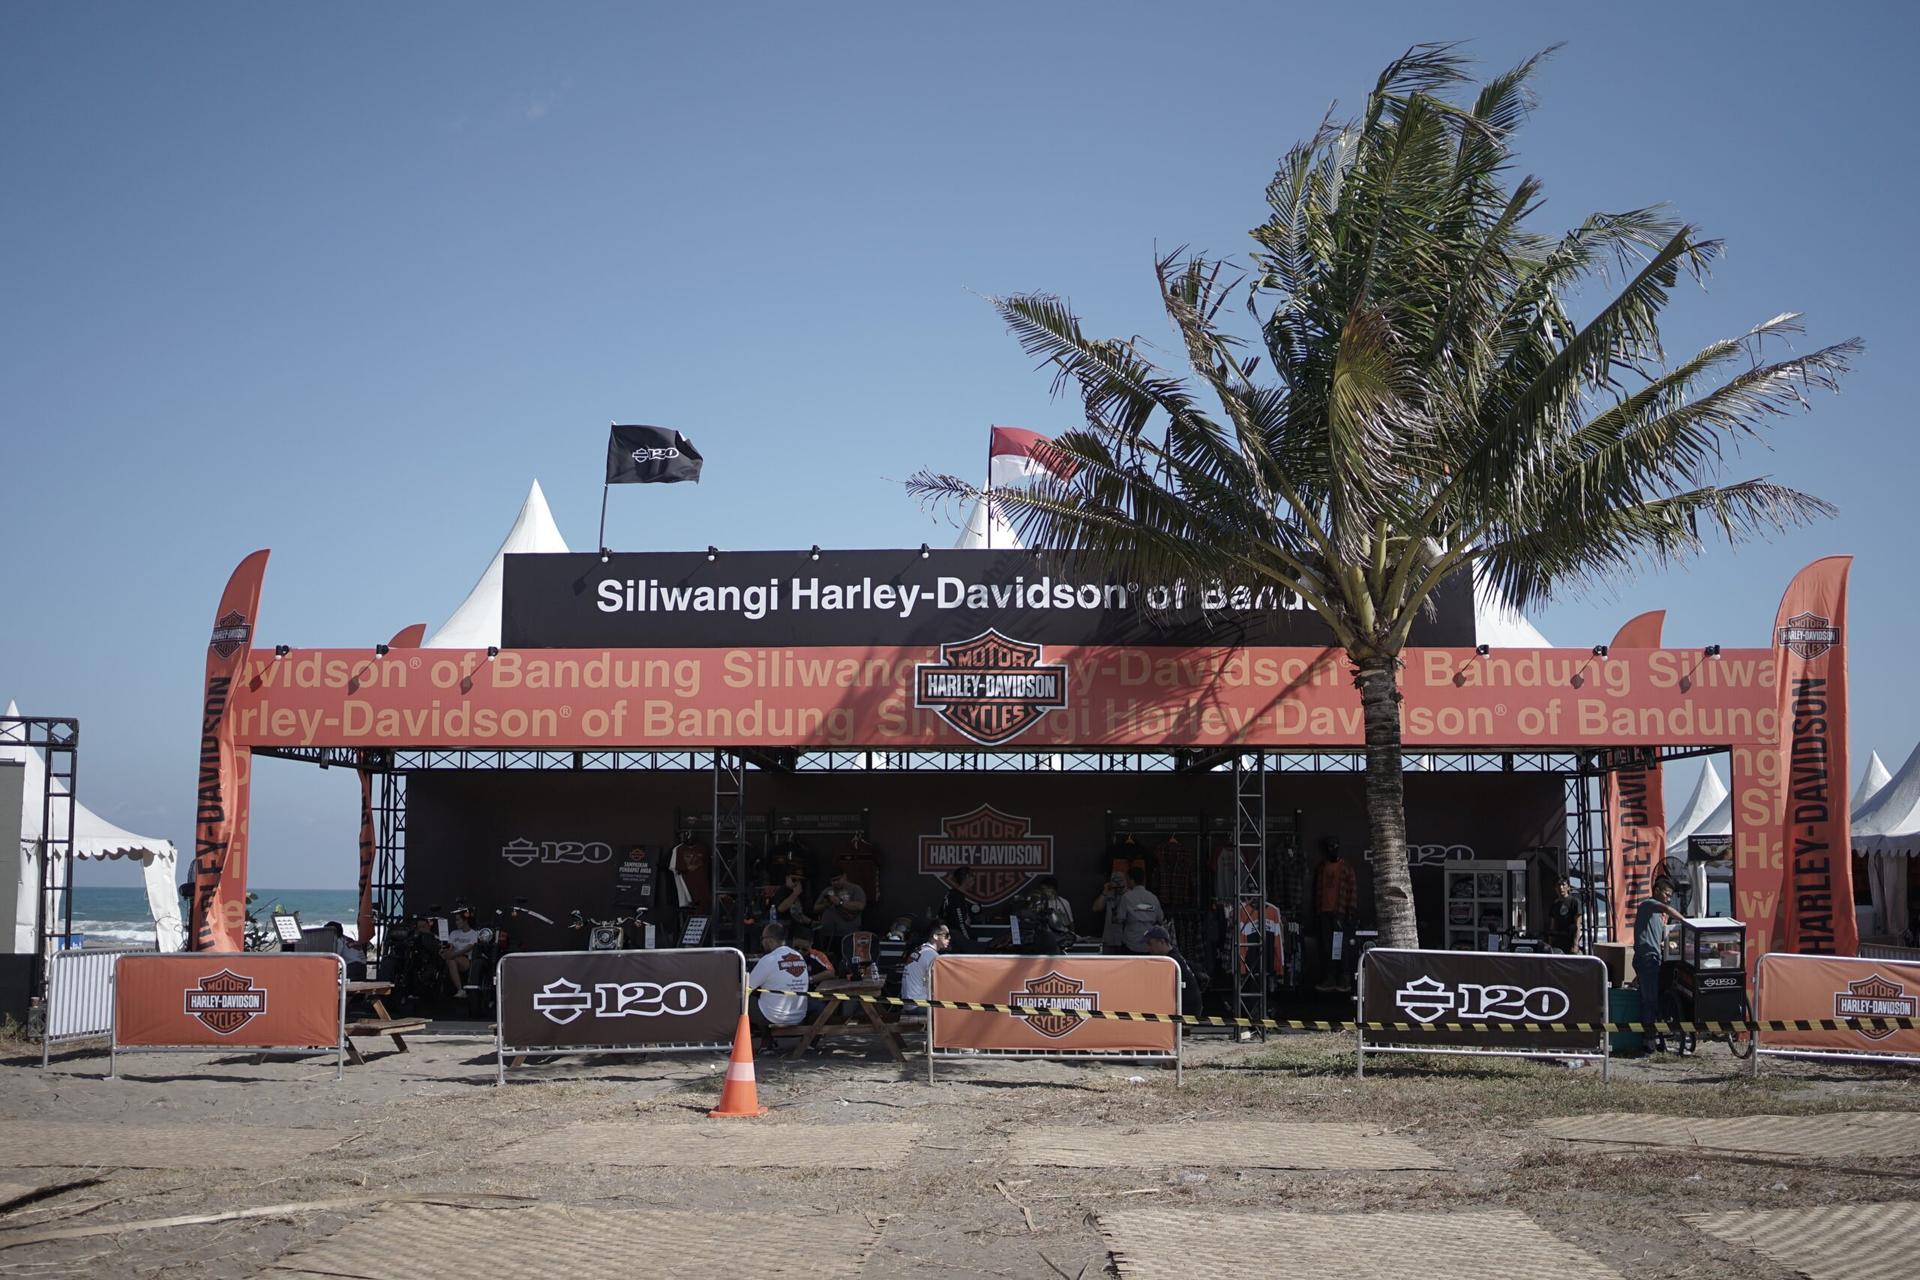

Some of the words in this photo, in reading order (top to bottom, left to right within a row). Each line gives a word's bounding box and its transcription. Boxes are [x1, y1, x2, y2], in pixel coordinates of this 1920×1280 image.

[597, 578, 778, 619] Siliwangi
[1783, 630, 1835, 642] HARLEY-DAVIDSON
[958, 640, 1025, 667] MOTOR
[430, 651, 476, 689] of
[492, 651, 701, 697] Bandung
[1424, 650, 1630, 697] Bandung
[928, 674, 1057, 698] HARLEY-DAVIDSON
[581, 699, 627, 738] of
[643, 699, 854, 744] Bandung
[1517, 699, 1562, 737] of
[1578, 698, 1779, 744] Bandung
[957, 705, 1025, 735] CYCLES
[1791, 678, 1836, 954] HARLEY-DAVIDSON
[956, 816, 1017, 838] MOTOR
[541, 842, 613, 863] 120
[930, 844, 1042, 865] HARLEY-DAVIDSON
[207, 976, 245, 991] MOTOR
[1034, 979, 1074, 994] MOTOR
[1857, 982, 1895, 998] MOTOR
[191, 995, 260, 1008] HARLEY-DAVIDSON
[595, 981, 708, 1017] 120
[1017, 997, 1092, 1011] HARLEY-DAVIDSON
[1458, 983, 1570, 1021] 120
[1841, 998, 1911, 1015] HARLEY-DAVIDSON
[206, 1012, 243, 1028] CYCLES
[1034, 1015, 1074, 1033] CYCLES
